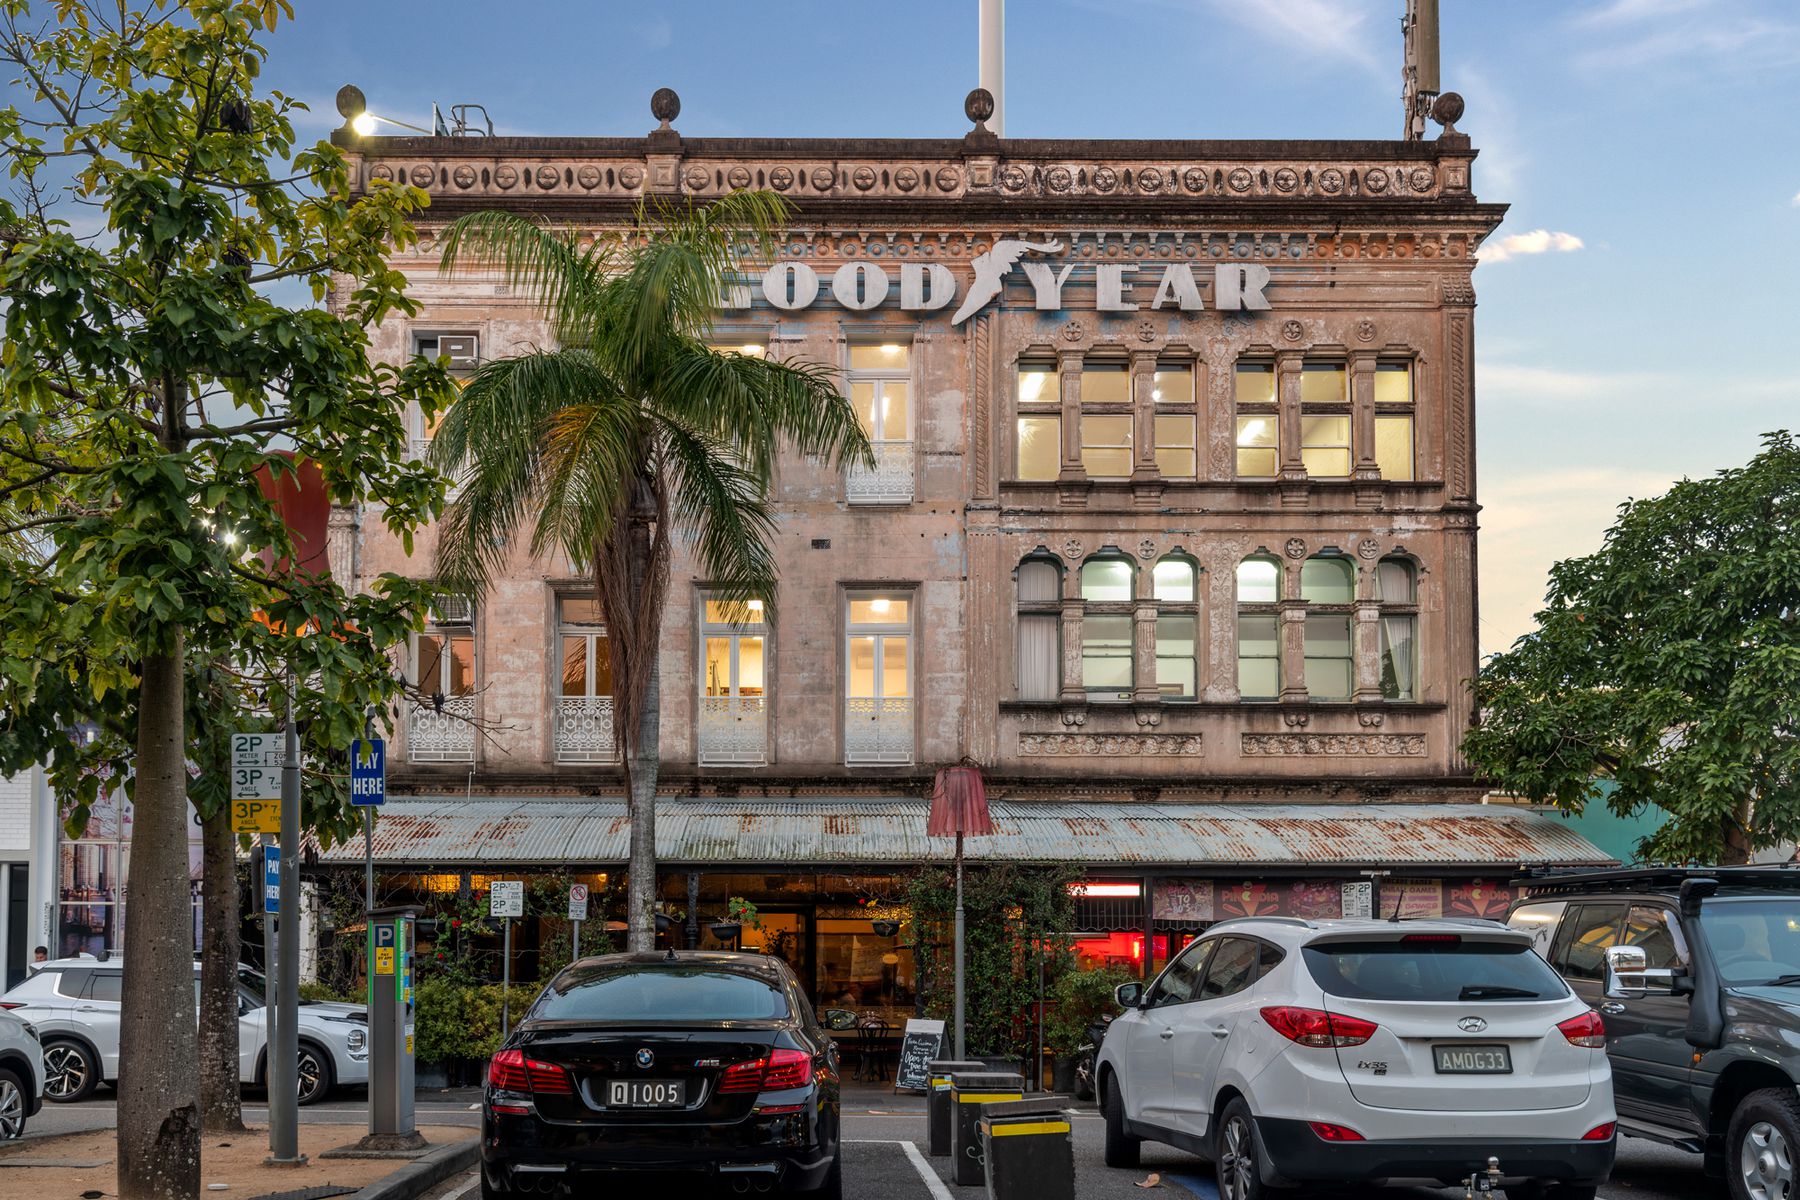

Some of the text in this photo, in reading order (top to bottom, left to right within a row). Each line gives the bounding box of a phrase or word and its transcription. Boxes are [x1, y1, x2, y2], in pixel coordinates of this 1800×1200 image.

[235, 736, 262, 752] 2P
[236, 769, 263, 785] 3P
[353, 777, 383, 795] HERE
[236, 803, 262, 818] 3P
[268, 859, 280, 874] PAY
[267, 884, 280, 899] HER
[492, 883, 506, 891] 2P
[1343, 884, 1355, 893] 2P
[1358, 884, 1371, 892] 2P
[492, 900, 506, 909] 2P
[1177, 894, 1190, 904] TO
[378, 928, 393, 946] P
[1357, 1060, 1388, 1070] ix35
